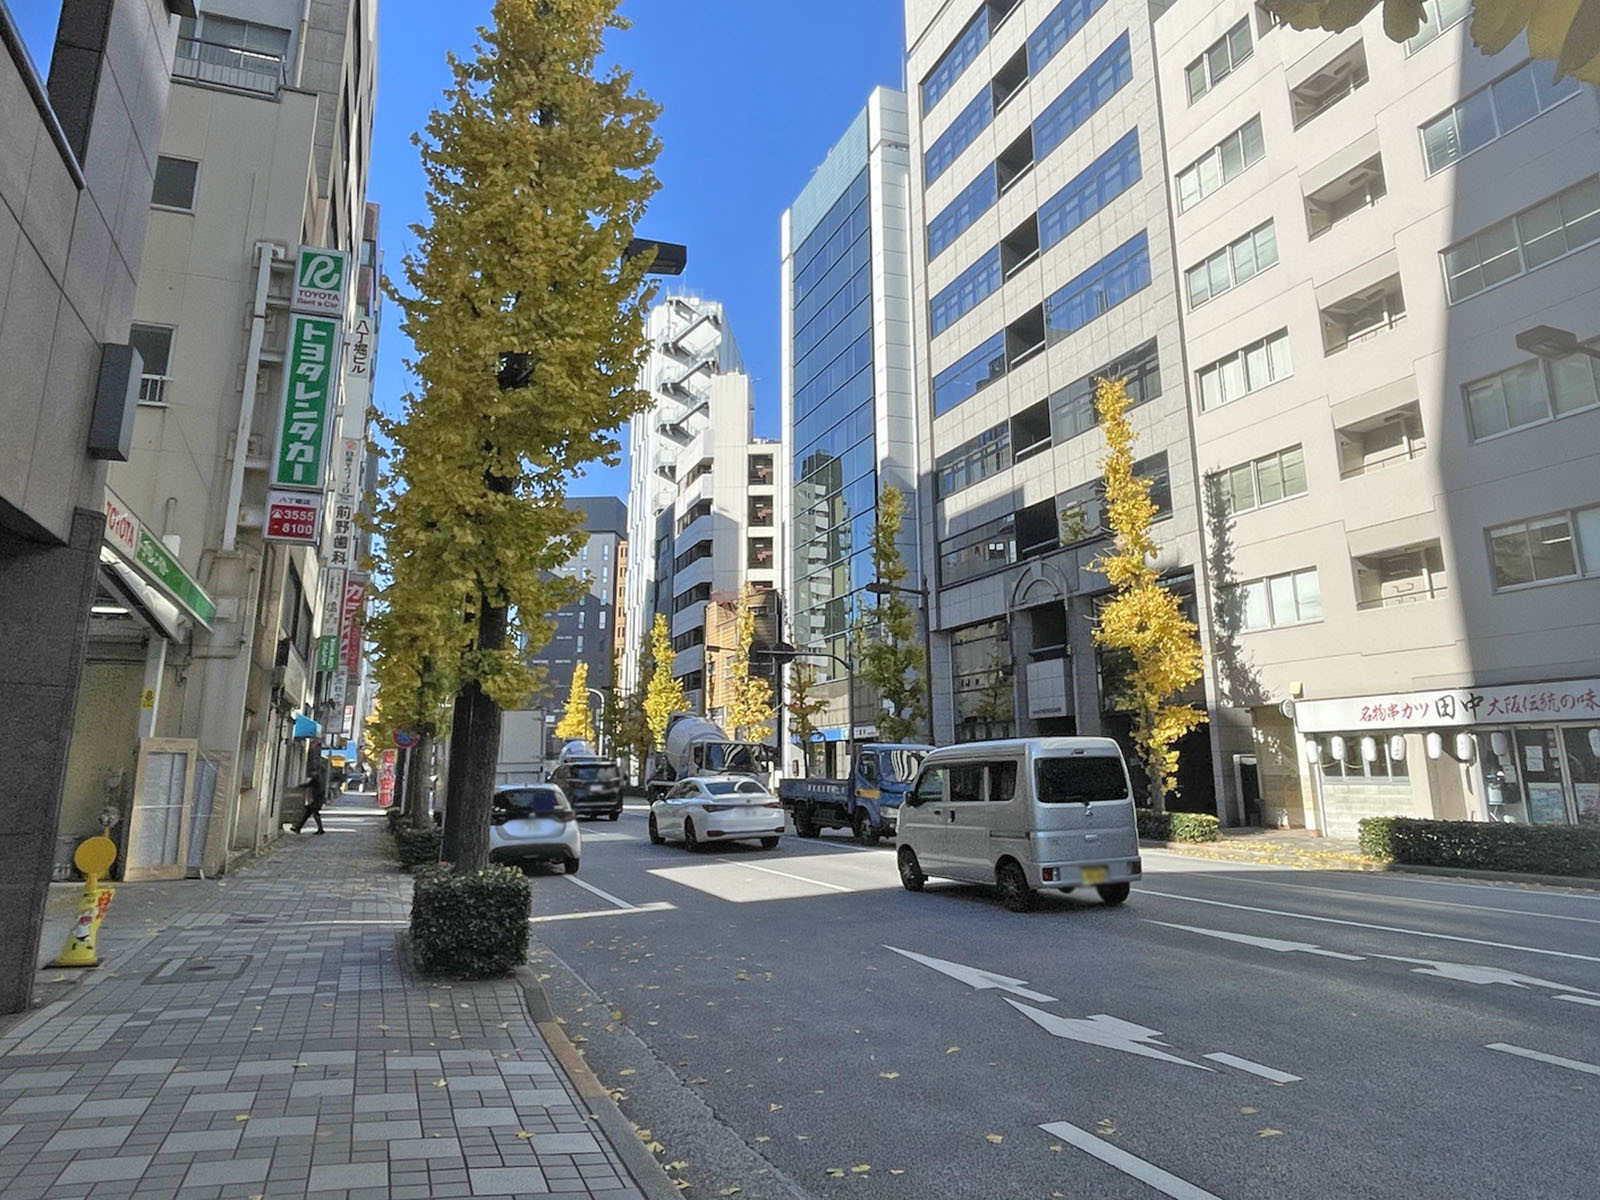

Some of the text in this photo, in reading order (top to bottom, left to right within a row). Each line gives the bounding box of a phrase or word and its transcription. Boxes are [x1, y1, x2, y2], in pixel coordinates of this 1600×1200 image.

[298, 289, 340, 301] TOYOTA
[352, 320, 370, 374] 八丁堀ビル
[285, 322, 327, 481] トヨタレンタカー
[106, 500, 135, 549] TOYOTA
[284, 509, 315, 521] 3555
[331, 505, 352, 565] 前野歯科
[1360, 687, 1600, 722] 名物串カツ 田中 大阪伝統の味
